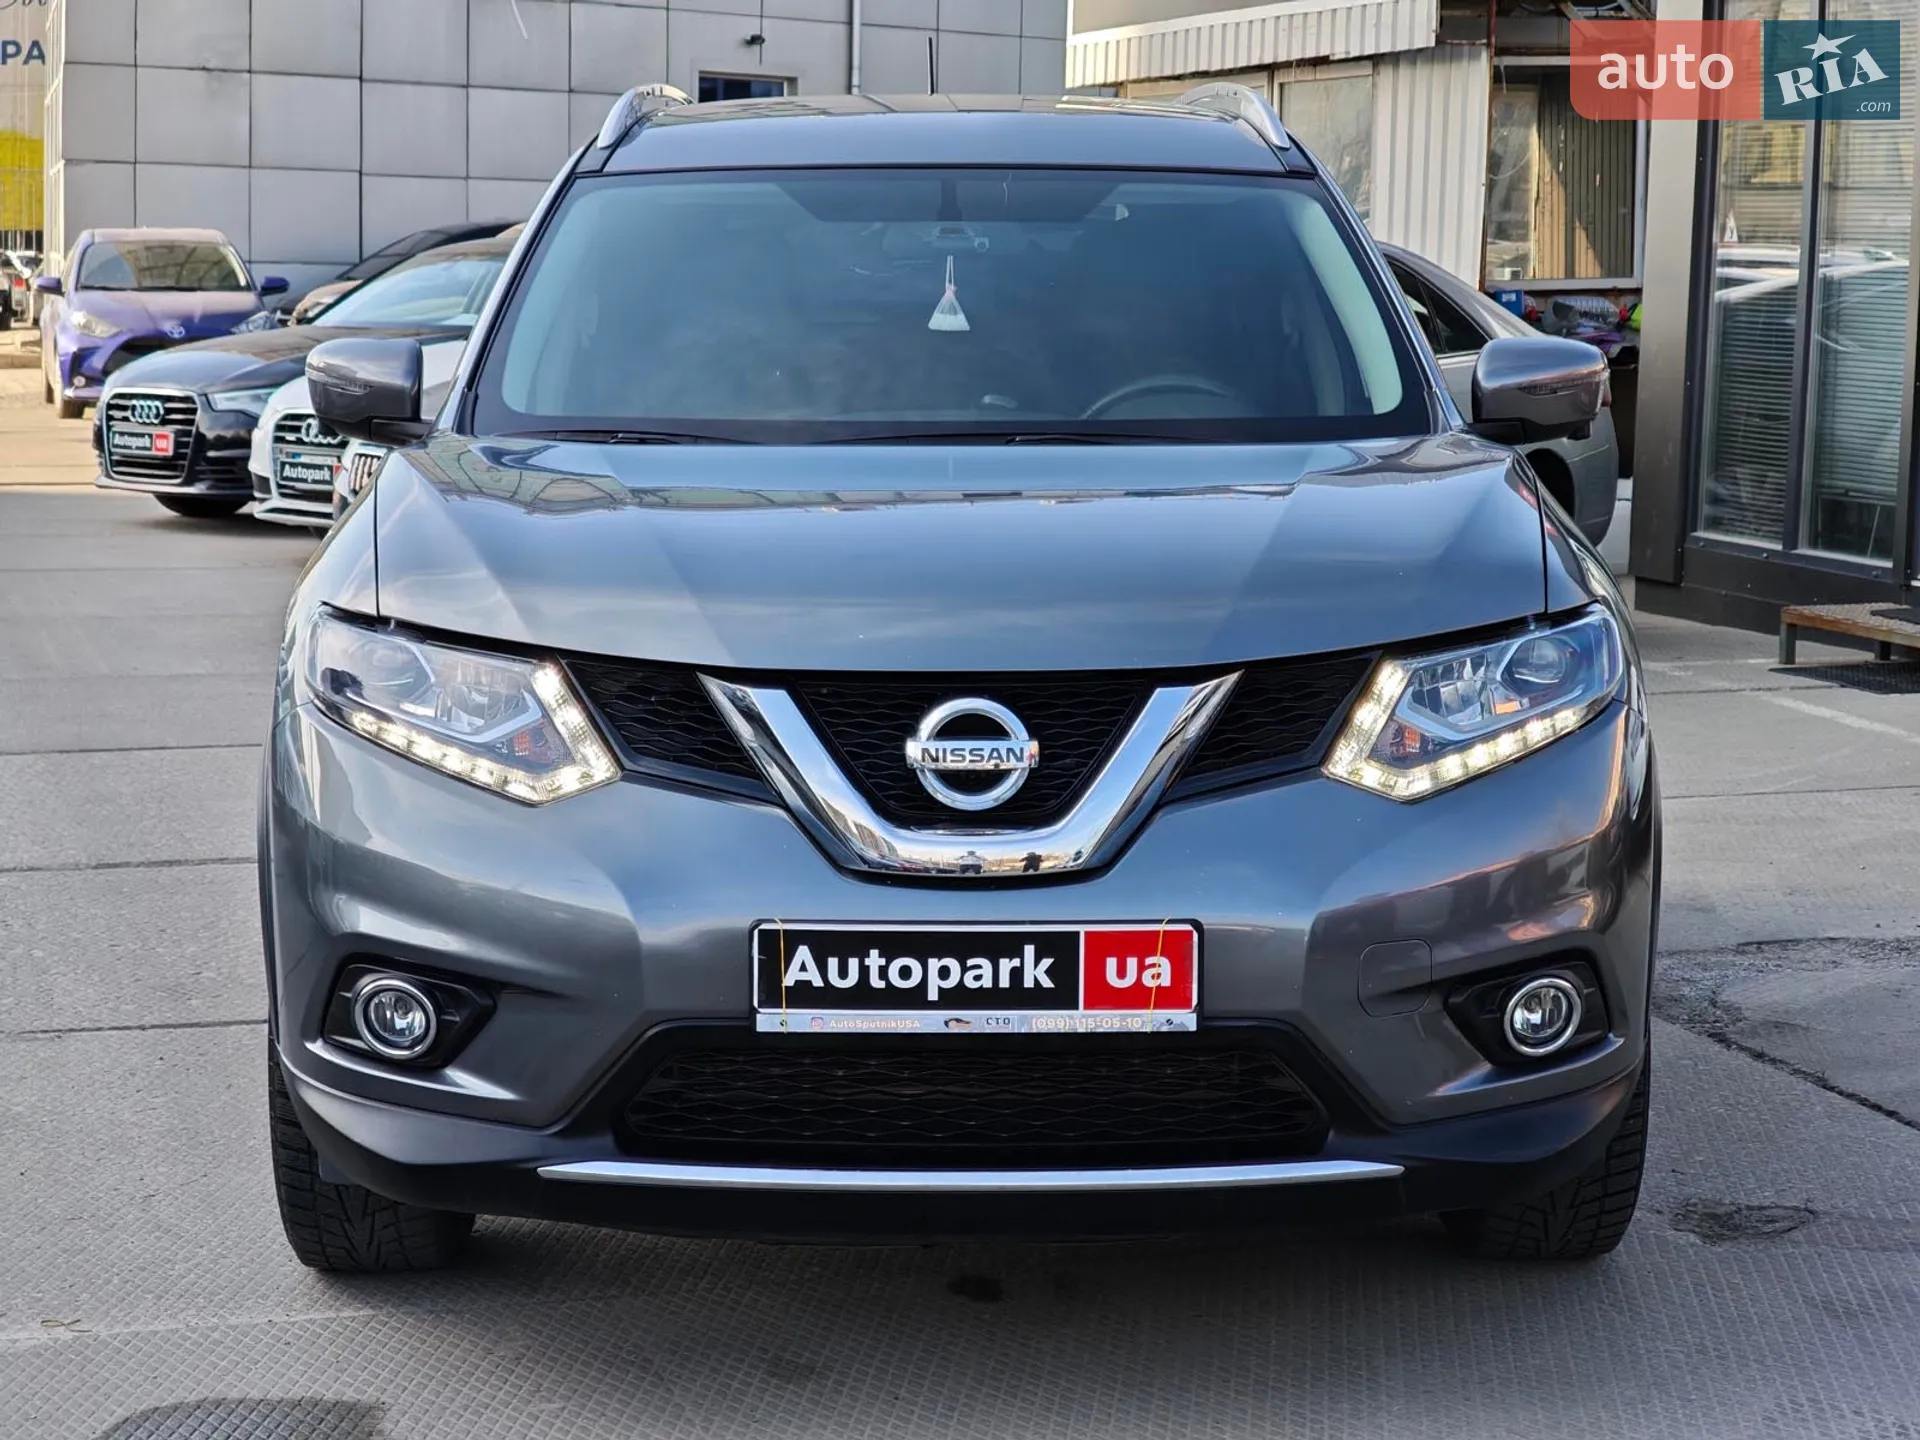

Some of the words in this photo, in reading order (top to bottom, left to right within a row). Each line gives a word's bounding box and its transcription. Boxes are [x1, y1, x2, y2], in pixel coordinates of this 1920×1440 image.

[113, 433, 151, 450] Autopark
[282, 464, 331, 483] Autopark
[920, 747, 1025, 764] NISSAN
[781, 944, 1056, 1001] Autopark
[1105, 955, 1172, 989] ua
[829, 1018, 921, 1031] AutoSputnikUSA
